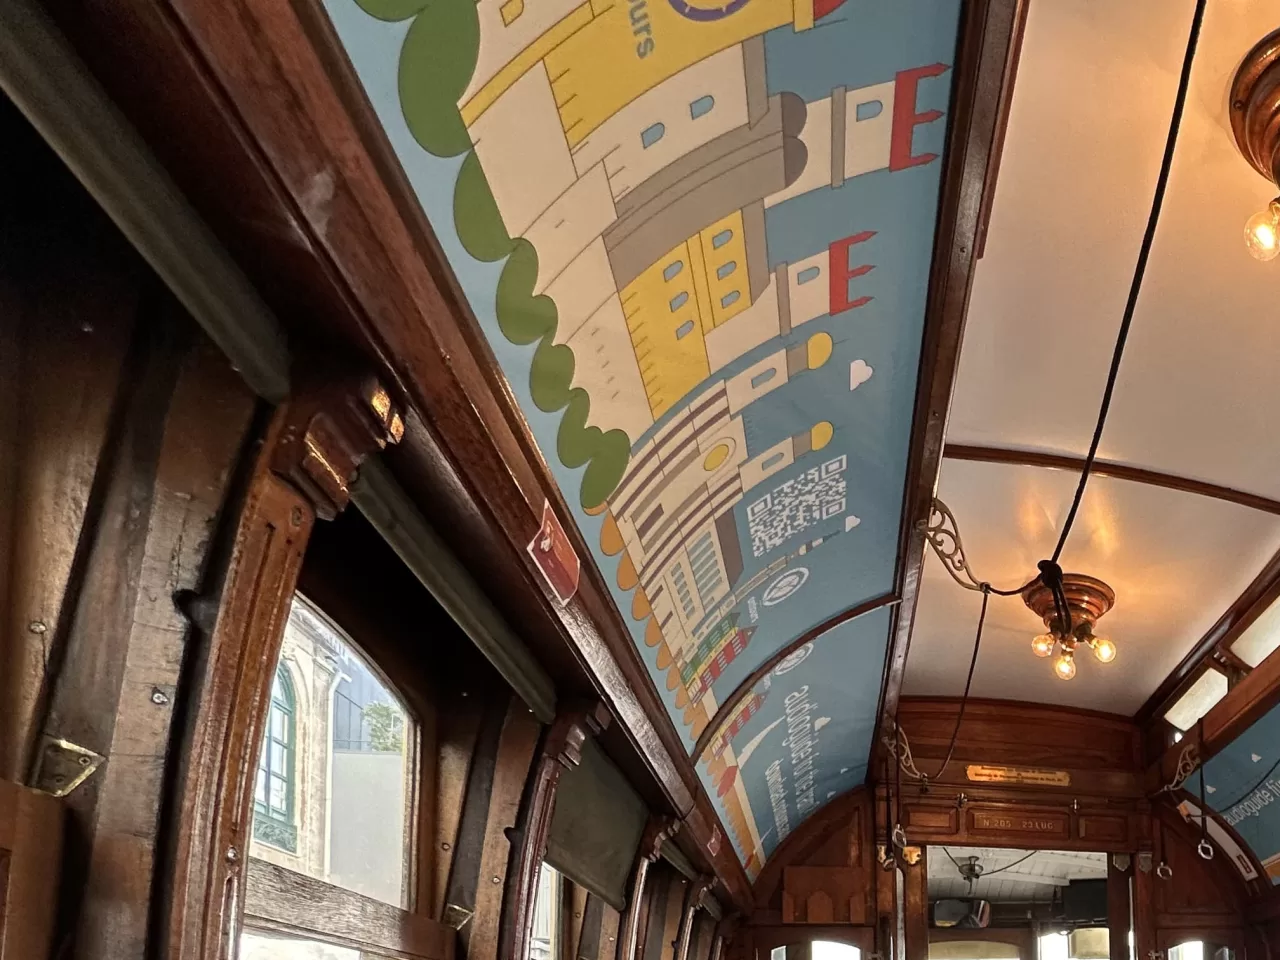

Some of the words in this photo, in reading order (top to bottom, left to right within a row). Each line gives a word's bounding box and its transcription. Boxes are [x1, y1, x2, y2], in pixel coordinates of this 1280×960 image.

[628, 0, 655, 59] urs
[782, 684, 820, 764] audioguide
[1223, 790, 1274, 826] audioguide
